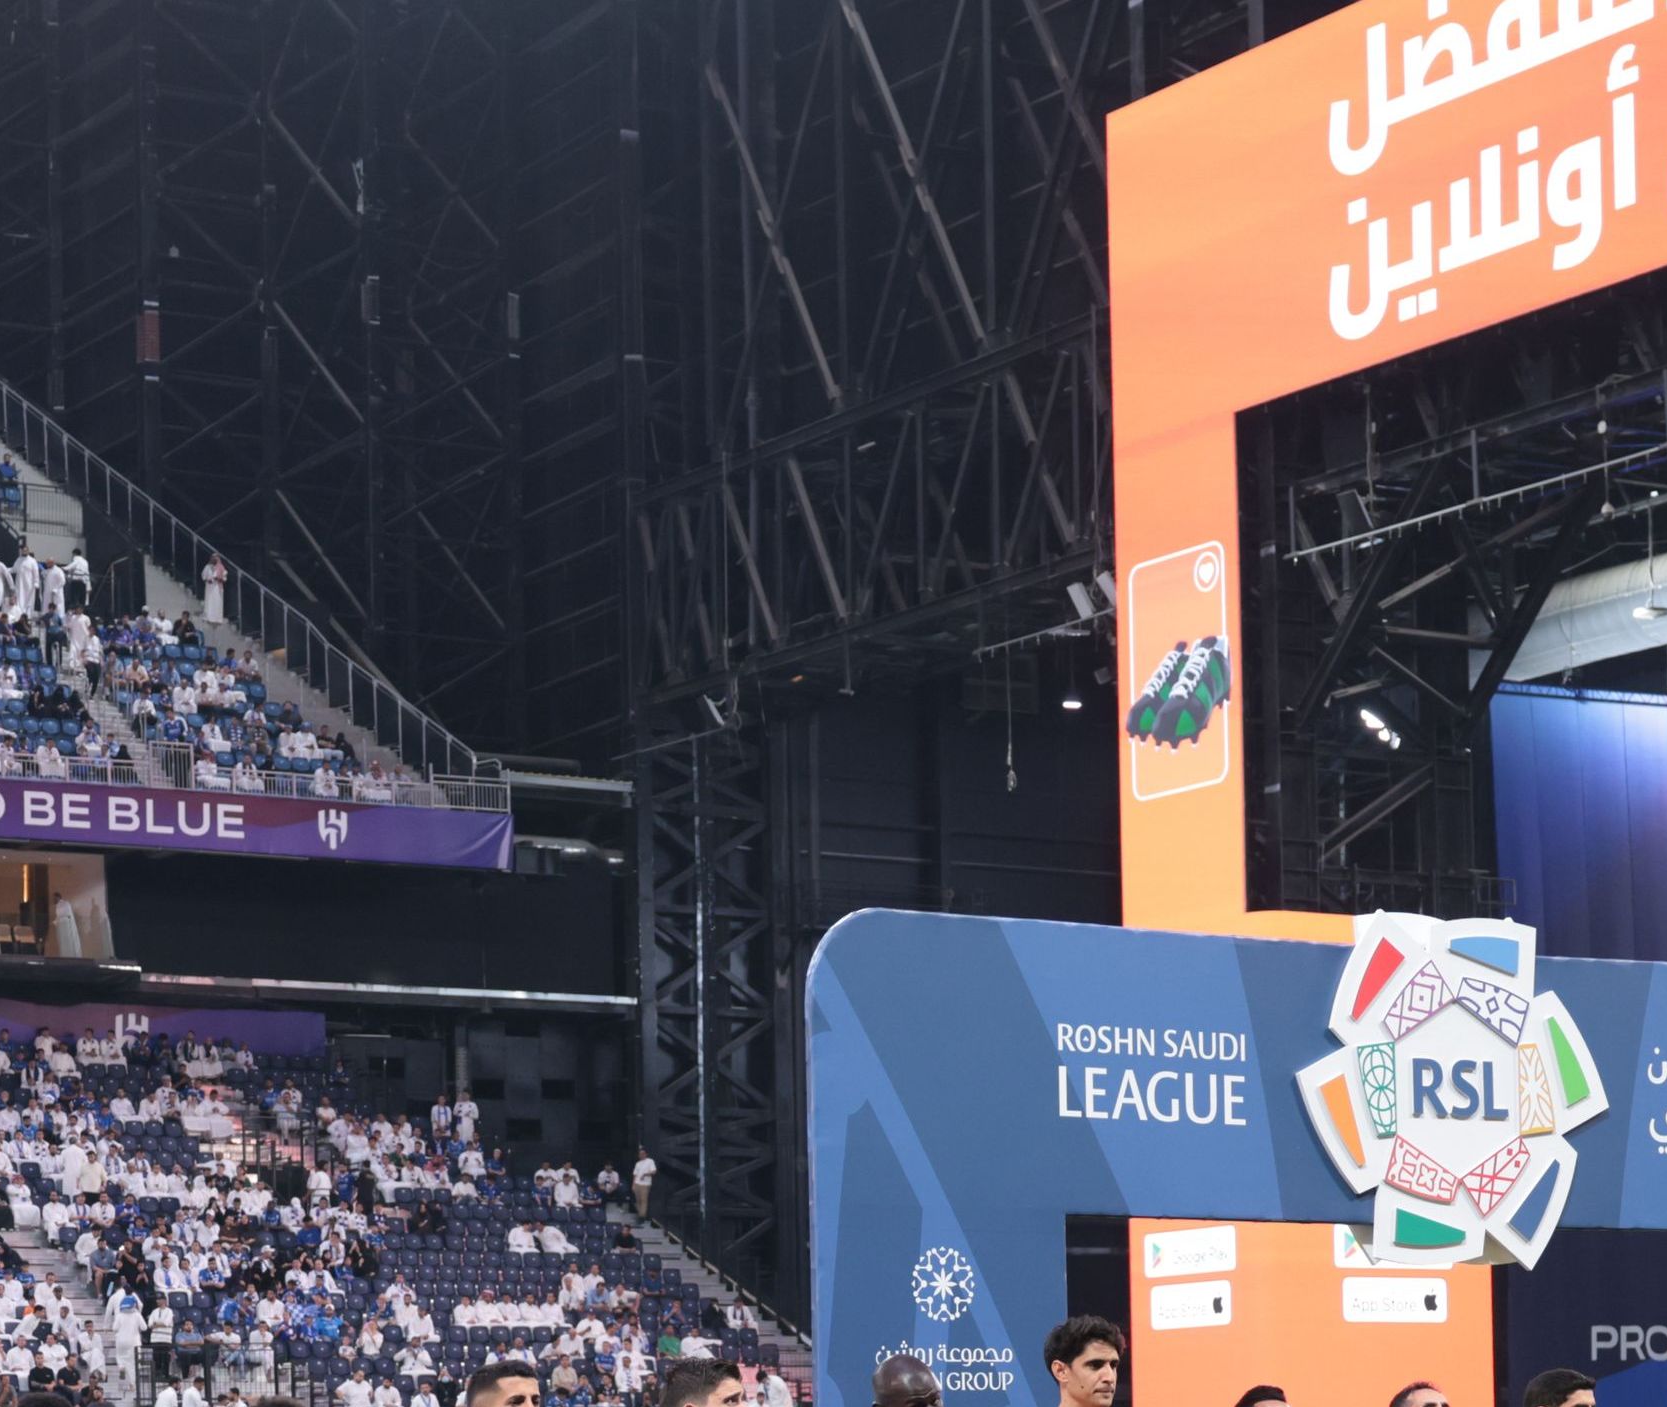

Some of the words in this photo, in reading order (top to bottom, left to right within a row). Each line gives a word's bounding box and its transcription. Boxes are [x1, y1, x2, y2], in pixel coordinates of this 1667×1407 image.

[1328, 43, 1640, 341] أونلاين
[23, 791, 91, 830] BE
[108, 796, 246, 840] BLUE
[1056, 1023, 1157, 1057] ROSHN
[1163, 1029, 1247, 1062] SAUDI
[1057, 1065, 1247, 1126] LEAGUE
[1411, 1057, 1509, 1121] RSL
[936, 1343, 1013, 1367] مجموعة
[946, 1371, 1014, 1391] GROUP
